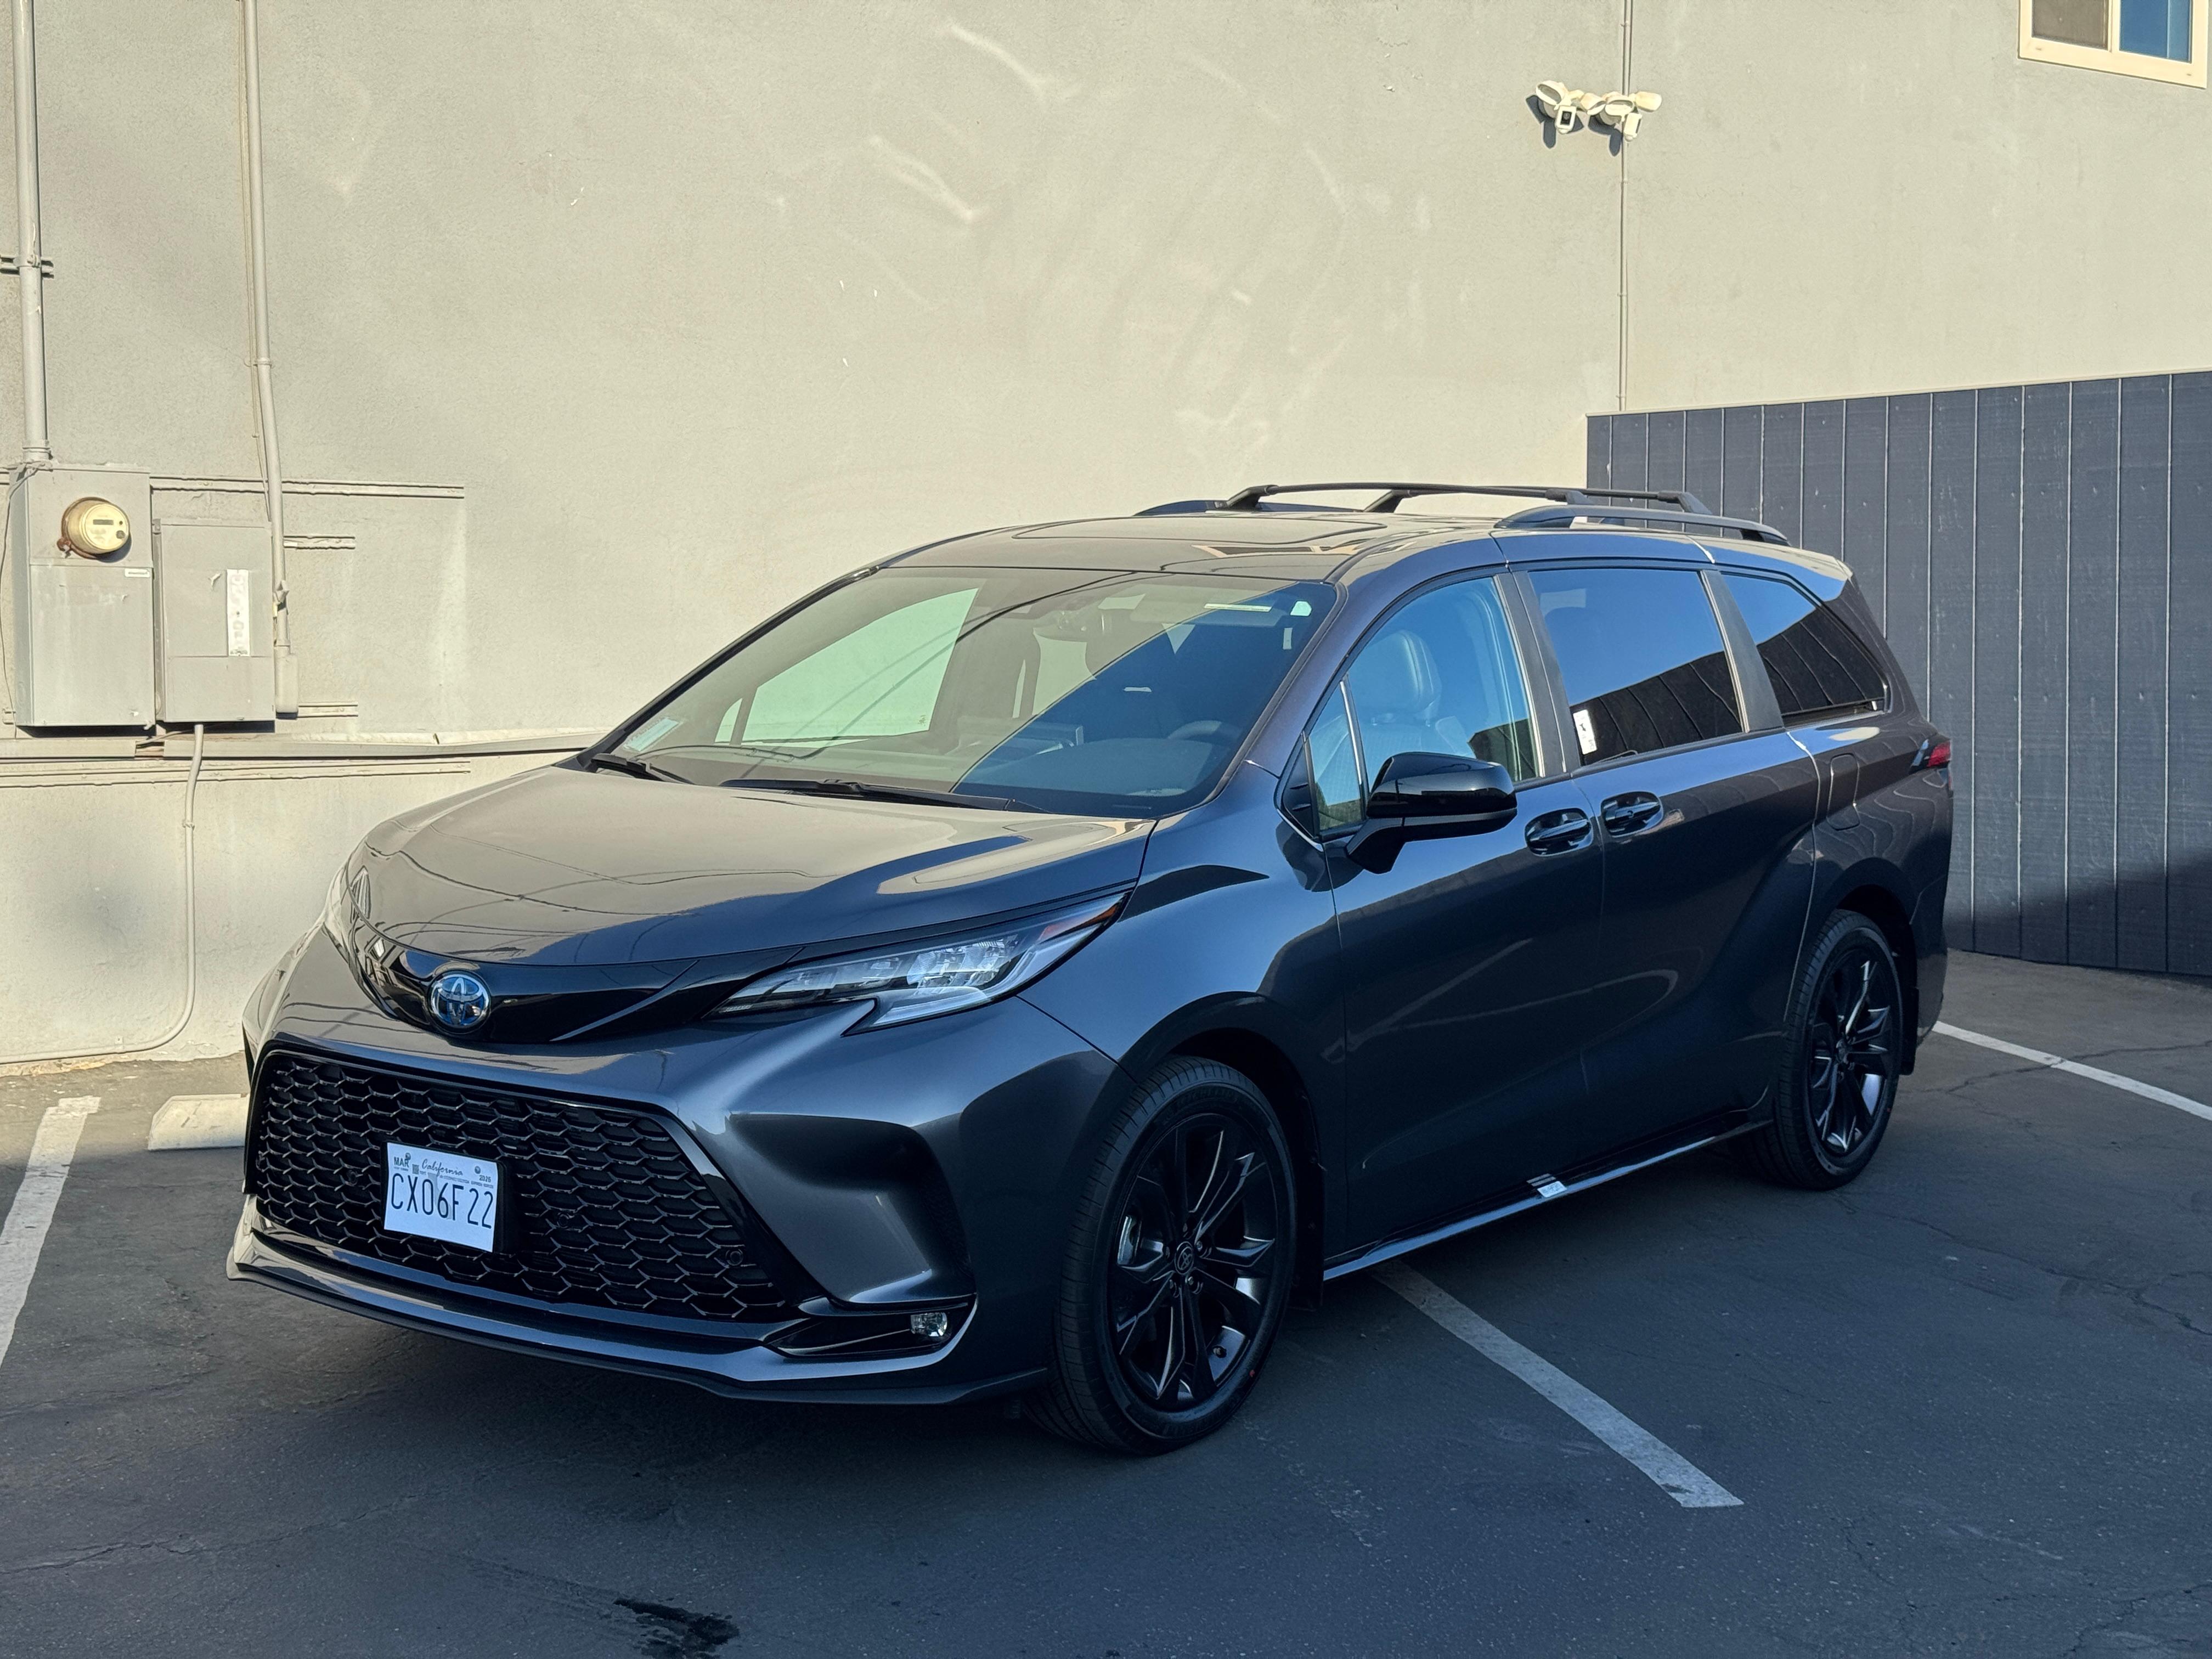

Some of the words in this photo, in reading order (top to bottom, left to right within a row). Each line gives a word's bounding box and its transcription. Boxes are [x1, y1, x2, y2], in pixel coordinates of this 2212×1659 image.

[394, 1156, 409, 1167] MAR
[422, 1159, 463, 1177] California
[391, 1173, 493, 1229] CX06F22
